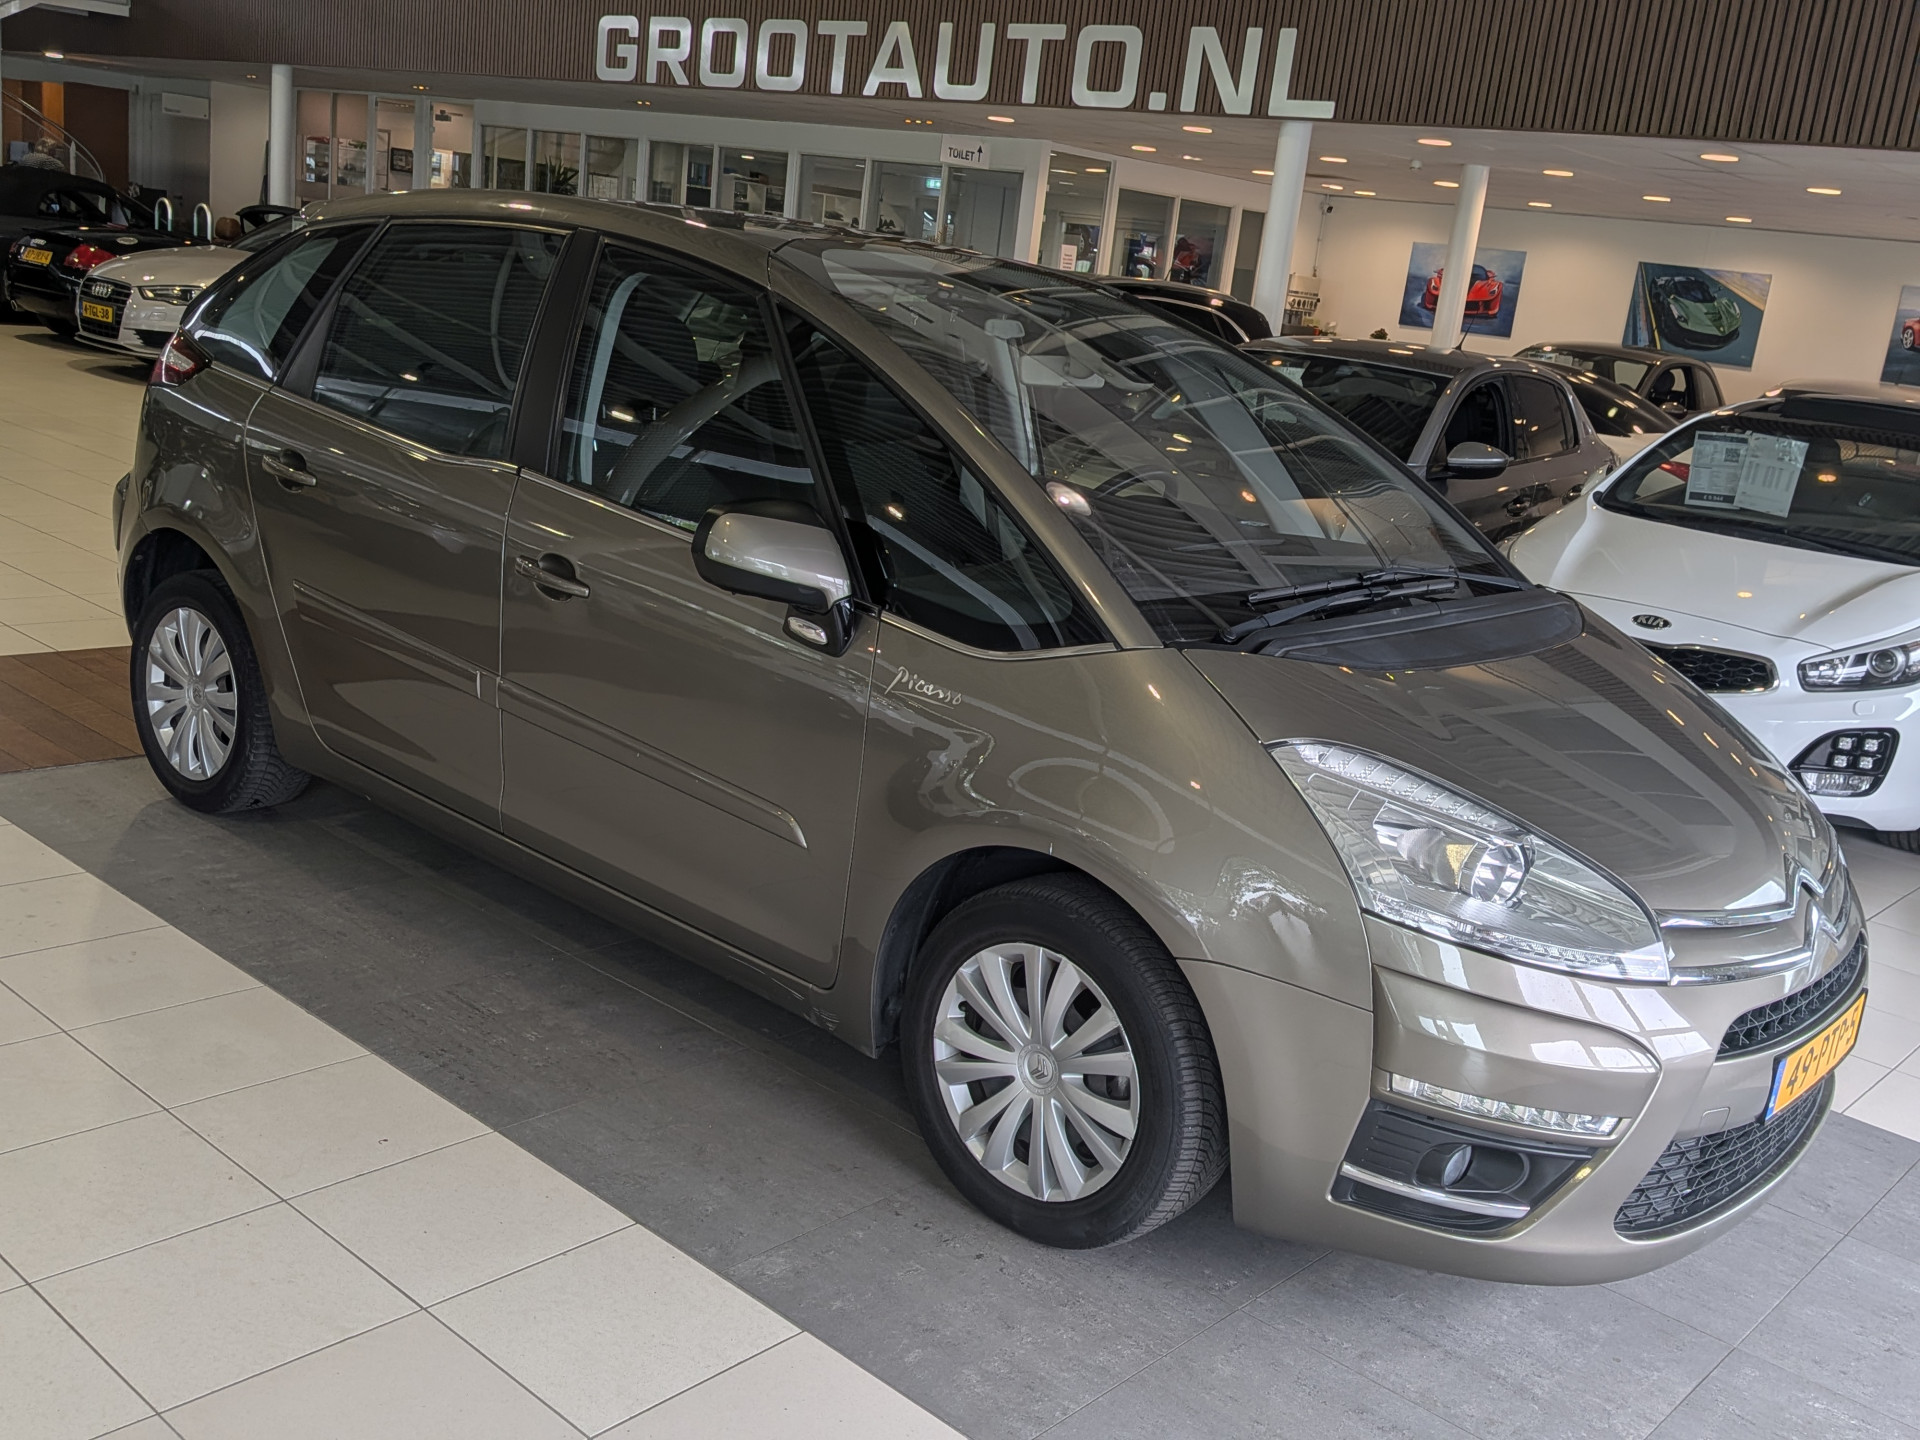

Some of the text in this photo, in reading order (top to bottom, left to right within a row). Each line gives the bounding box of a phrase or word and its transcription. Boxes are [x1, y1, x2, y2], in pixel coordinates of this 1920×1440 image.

[596, 15, 1336, 119] GROOTAUTO.NL
[948, 146, 975, 161] TOILET
[84, 303, 110, 320] 4-TGL-38
[1637, 615, 1664, 627] KIA
[1786, 1004, 1860, 1096] 49-PTP-5
